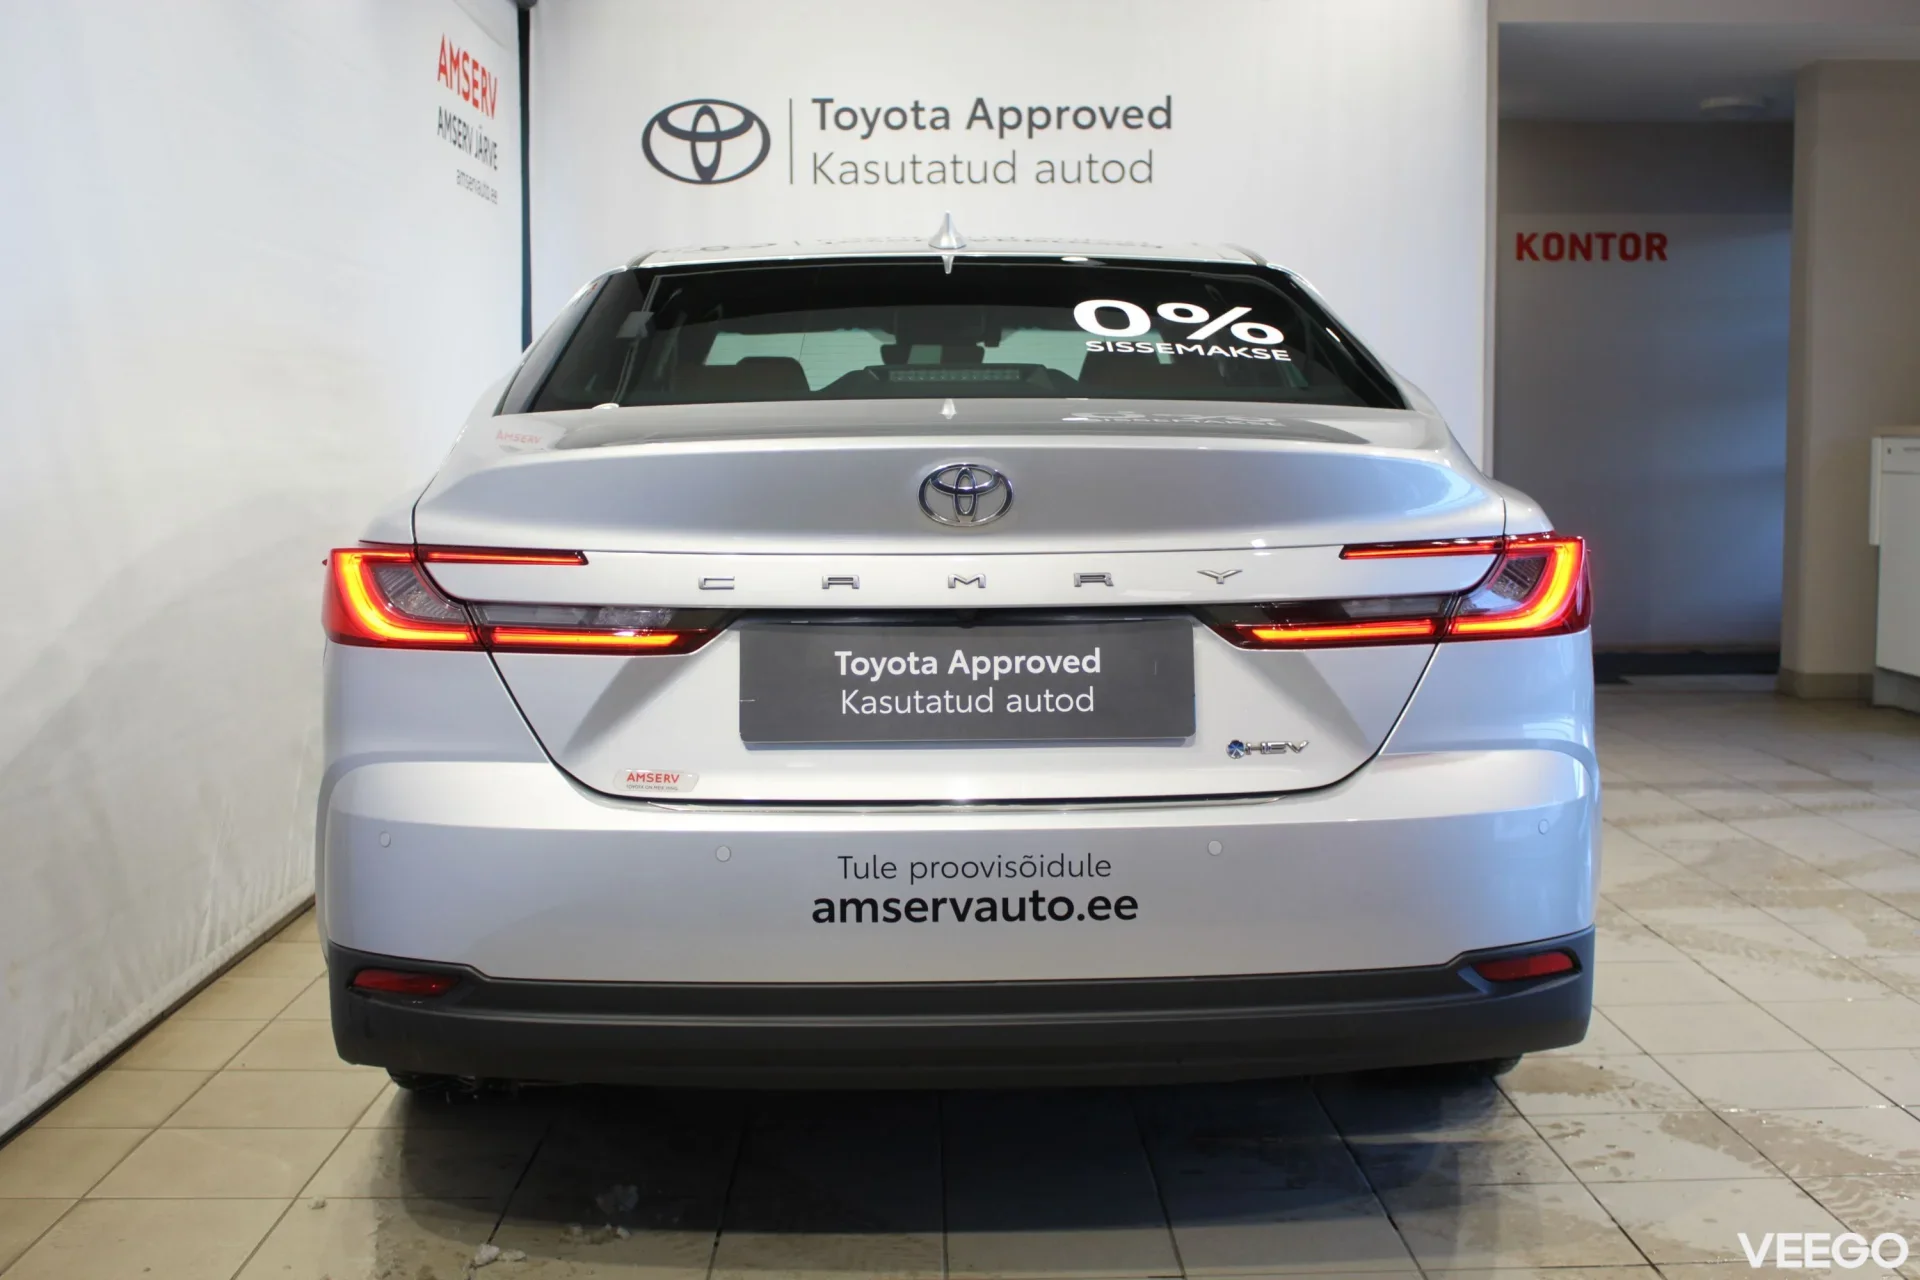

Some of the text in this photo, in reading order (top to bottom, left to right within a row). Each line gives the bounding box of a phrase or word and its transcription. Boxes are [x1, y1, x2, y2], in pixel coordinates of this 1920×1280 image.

[437, 32, 498, 120] AMSERV
[812, 96, 1172, 139] Toyota Approved
[437, 105, 498, 171] AMSERV JÄRVE
[813, 149, 1154, 185] Kasutatud autod
[1515, 231, 1669, 263] KONTOR
[1073, 299, 1285, 345] 0%
[1085, 340, 1292, 362] SISSEMAKSE
[698, 568, 1243, 591] CAMRY
[834, 647, 1101, 682] Toyota Approved
[841, 685, 1094, 714] Kasutatud autod
[626, 772, 680, 784] AMSERV
[837, 853, 1112, 885] Tule proovisõidule
[811, 889, 1139, 924] amservauto.ee
